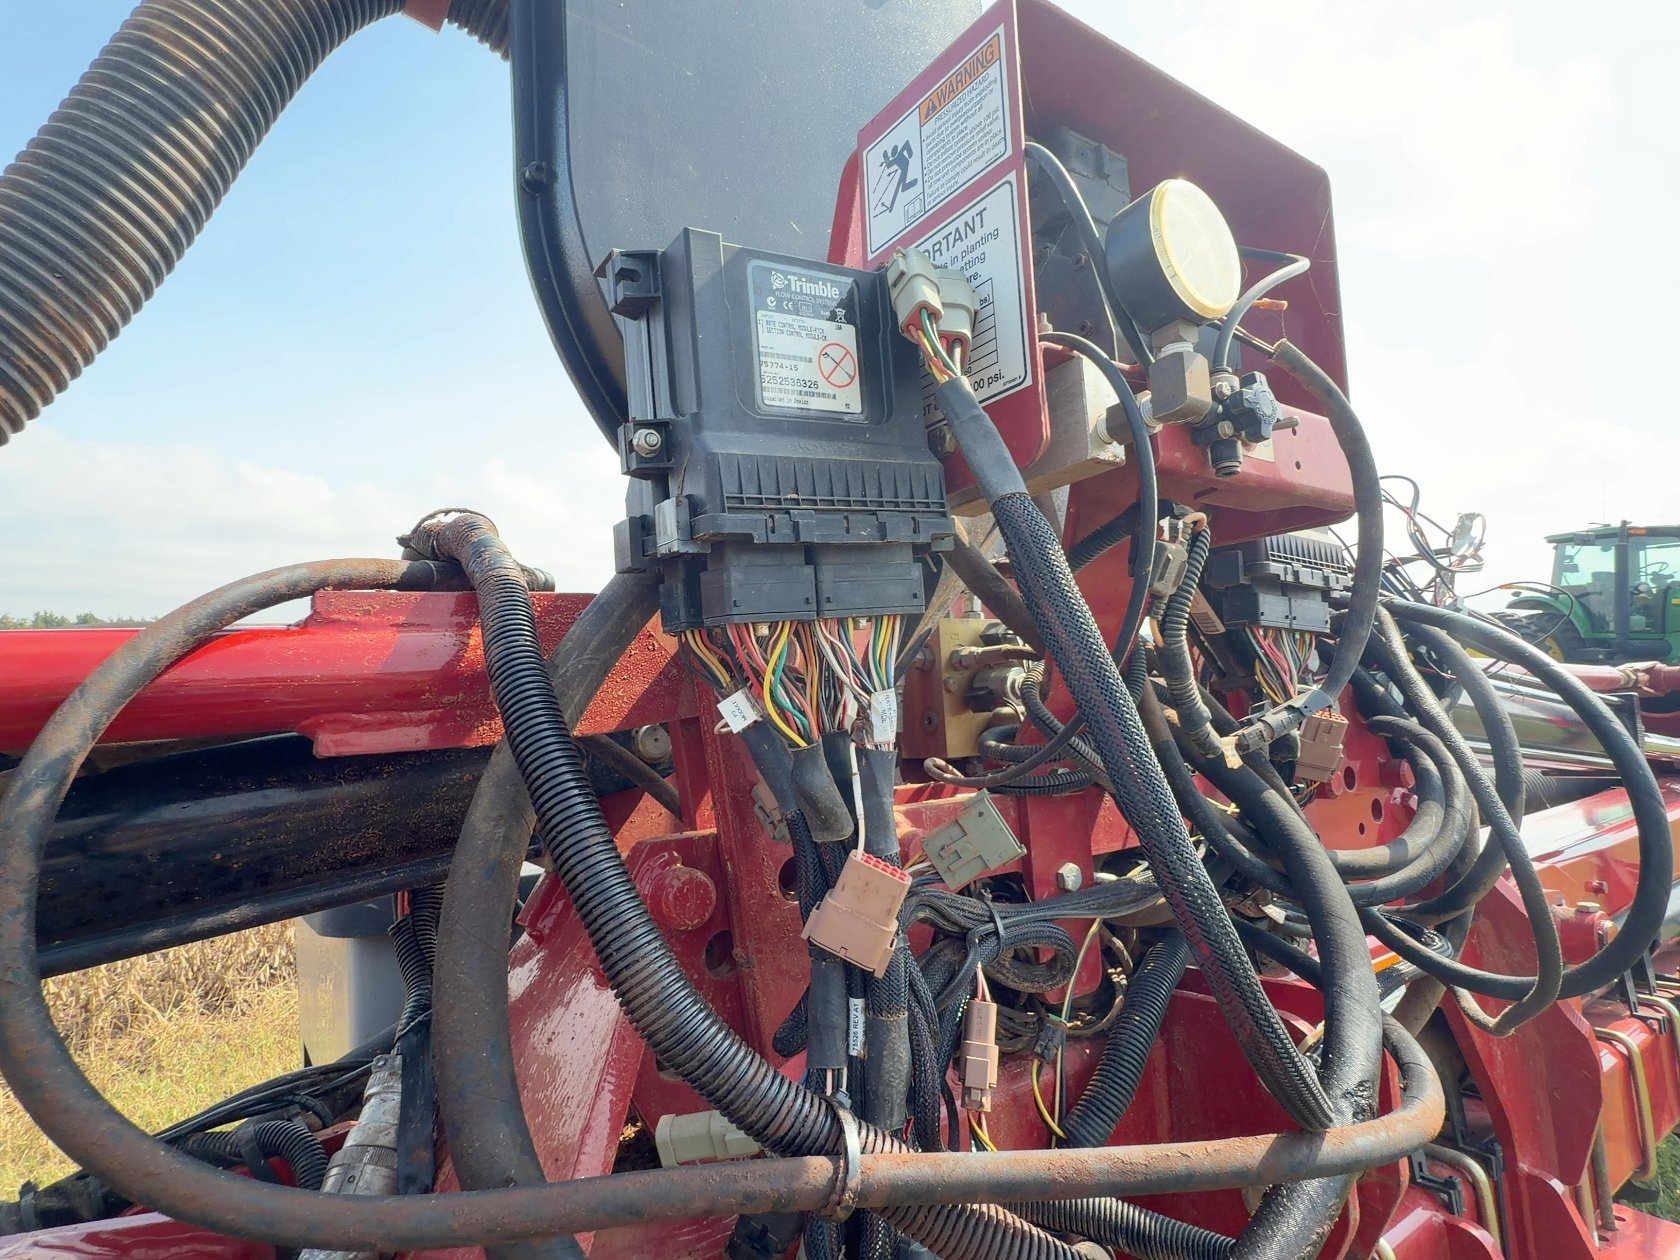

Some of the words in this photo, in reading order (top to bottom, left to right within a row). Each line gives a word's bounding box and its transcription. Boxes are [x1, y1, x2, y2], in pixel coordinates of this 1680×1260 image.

[937, 44, 994, 108] WARNING
[925, 128, 936, 141] Avoid
[937, 115, 951, 131] serious
[951, 104, 963, 119] injury
[964, 95, 974, 108] from
[975, 75, 997, 99] exploding
[934, 92, 966, 125] PRESSURIZED
[966, 71, 989, 97] HAZARD
[950, 255, 958, 266] in
[961, 228, 998, 261] planting
[960, 252, 985, 272] etting
[788, 275, 840, 298] Trimble
[967, 272, 981, 283] re.
[792, 294, 815, 303] CONTROL
[760, 361, 798, 371] 75774-15
[973, 378, 984, 392] 00
[988, 368, 1004, 388] psi.
